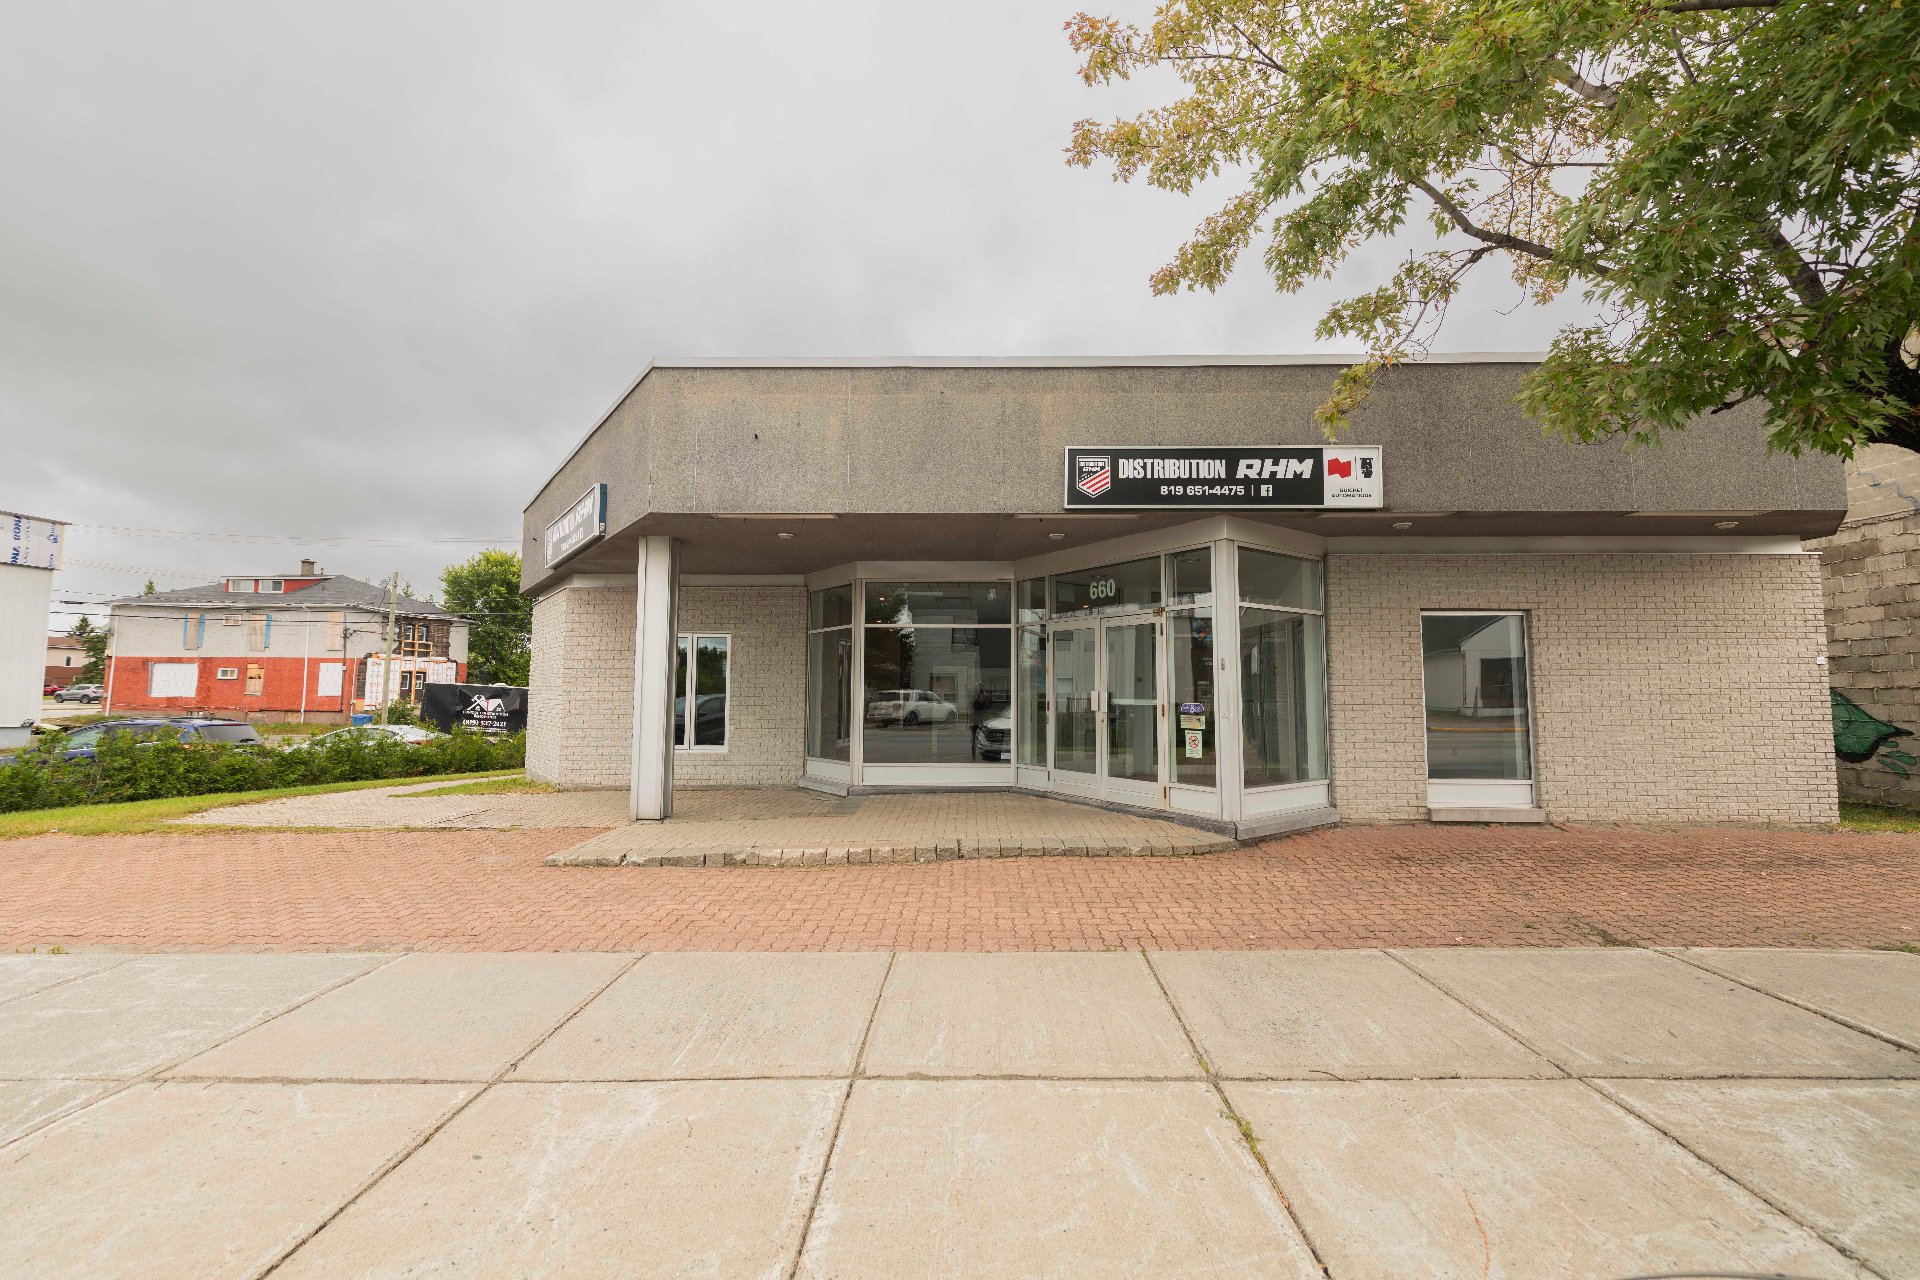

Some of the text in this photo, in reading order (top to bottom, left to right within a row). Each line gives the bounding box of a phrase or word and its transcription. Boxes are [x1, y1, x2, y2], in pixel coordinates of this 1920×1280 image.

[1118, 458, 1315, 479] DISTRIBUTION RHM
[1160, 485, 1184, 496] 819
[1186, 485, 1245, 496] 651-4475
[1089, 578, 1116, 600] 660
